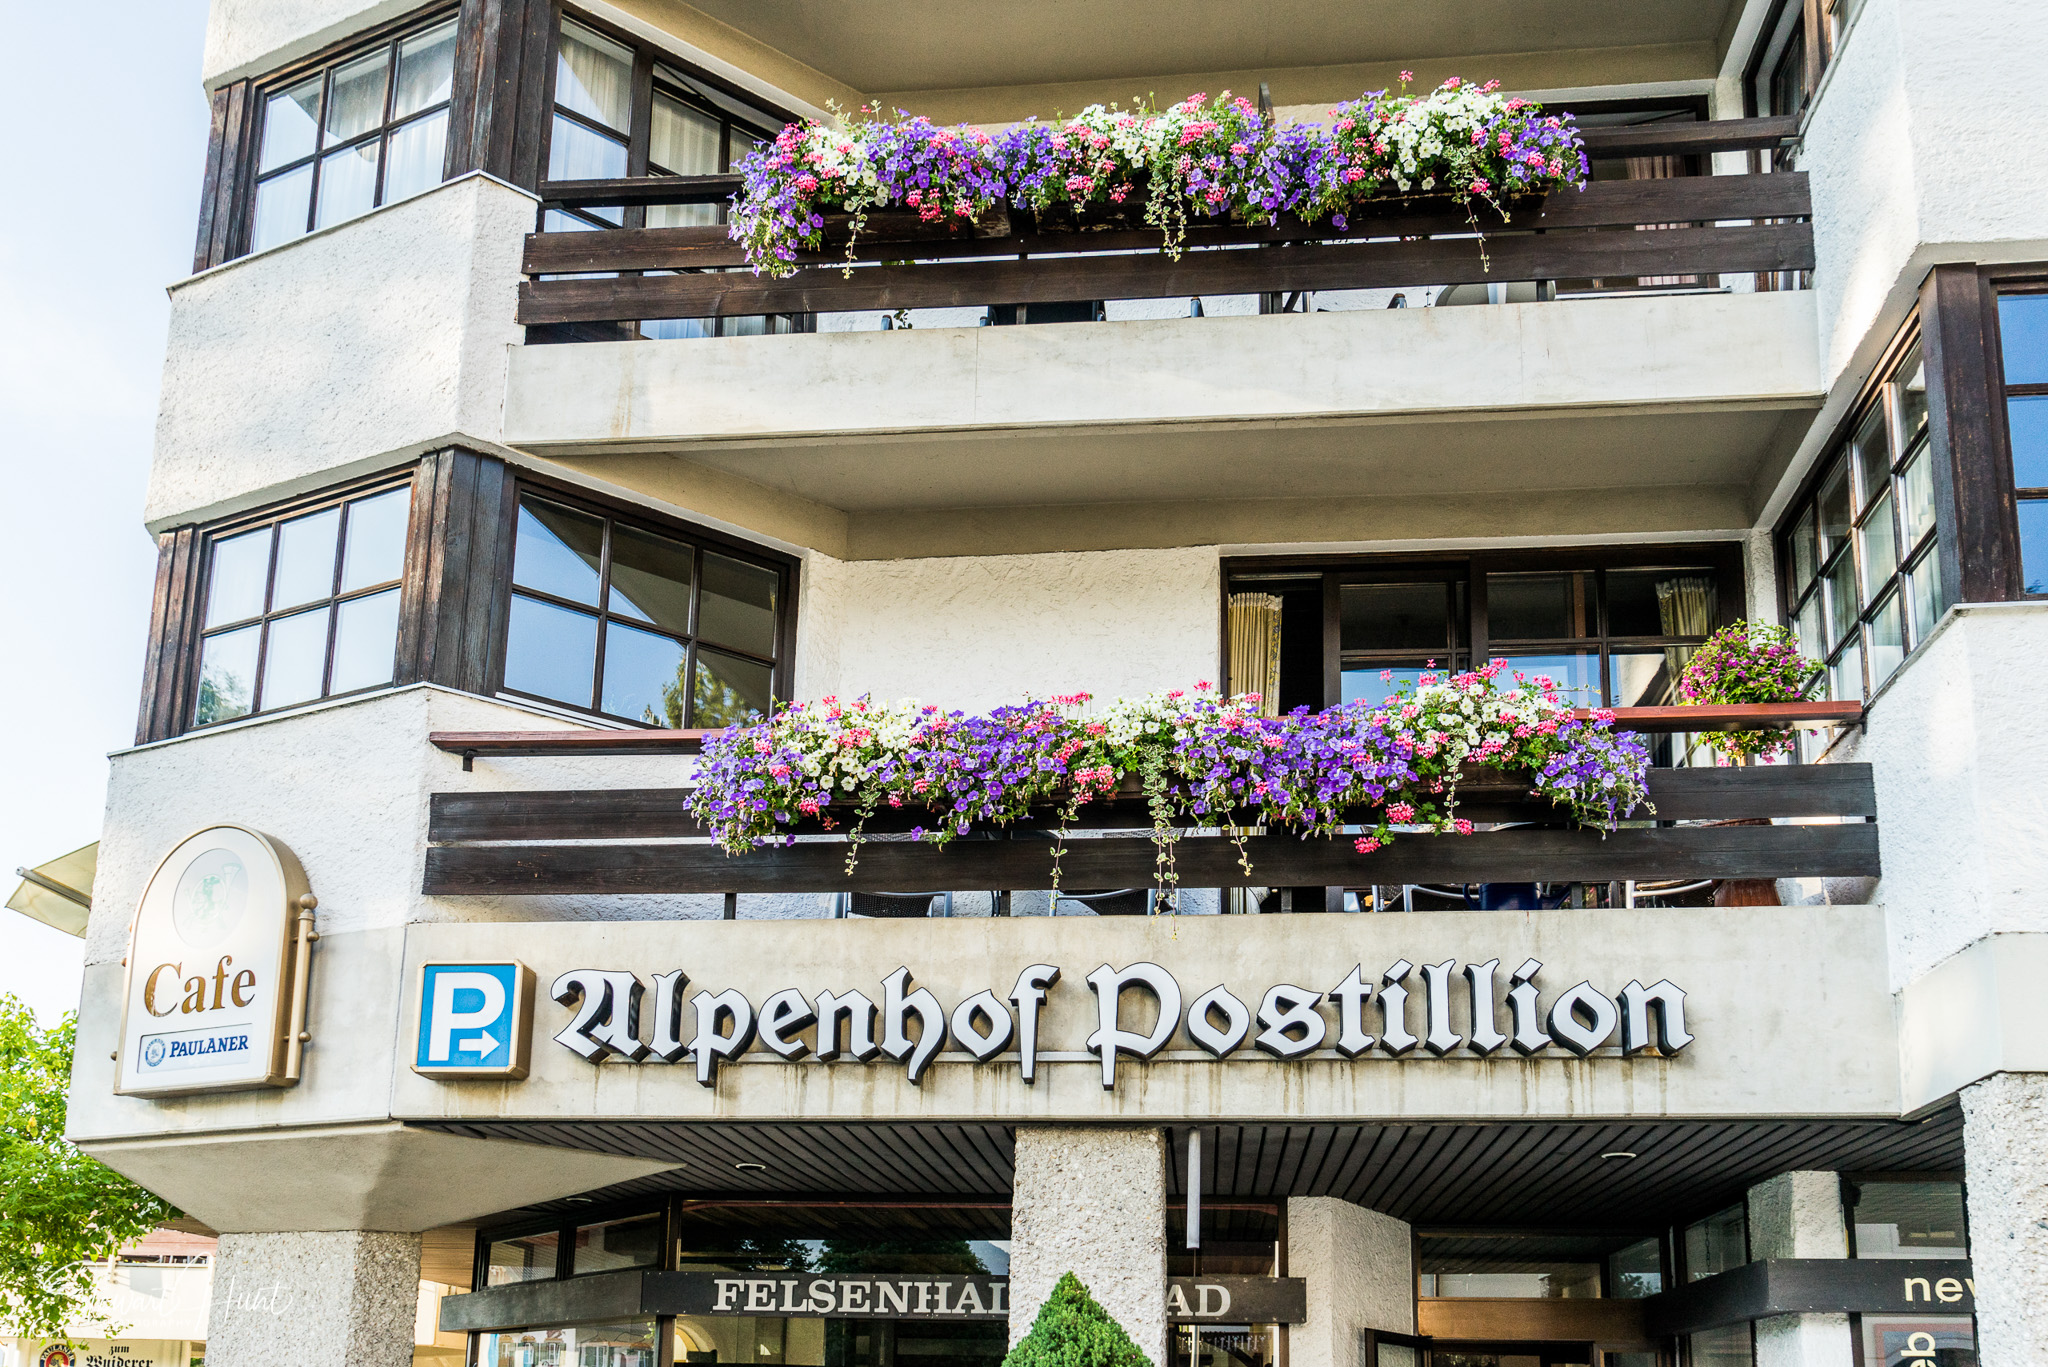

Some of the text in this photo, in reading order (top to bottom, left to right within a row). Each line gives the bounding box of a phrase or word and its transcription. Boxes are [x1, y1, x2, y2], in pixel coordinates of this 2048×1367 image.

[144, 954, 256, 1018] Cafe
[428, 971, 506, 1062] P
[169, 1034, 249, 1059] PAULANER
[550, 957, 1695, 1091] Alpenhof Postillion
[108, 1345, 130, 1355] zum
